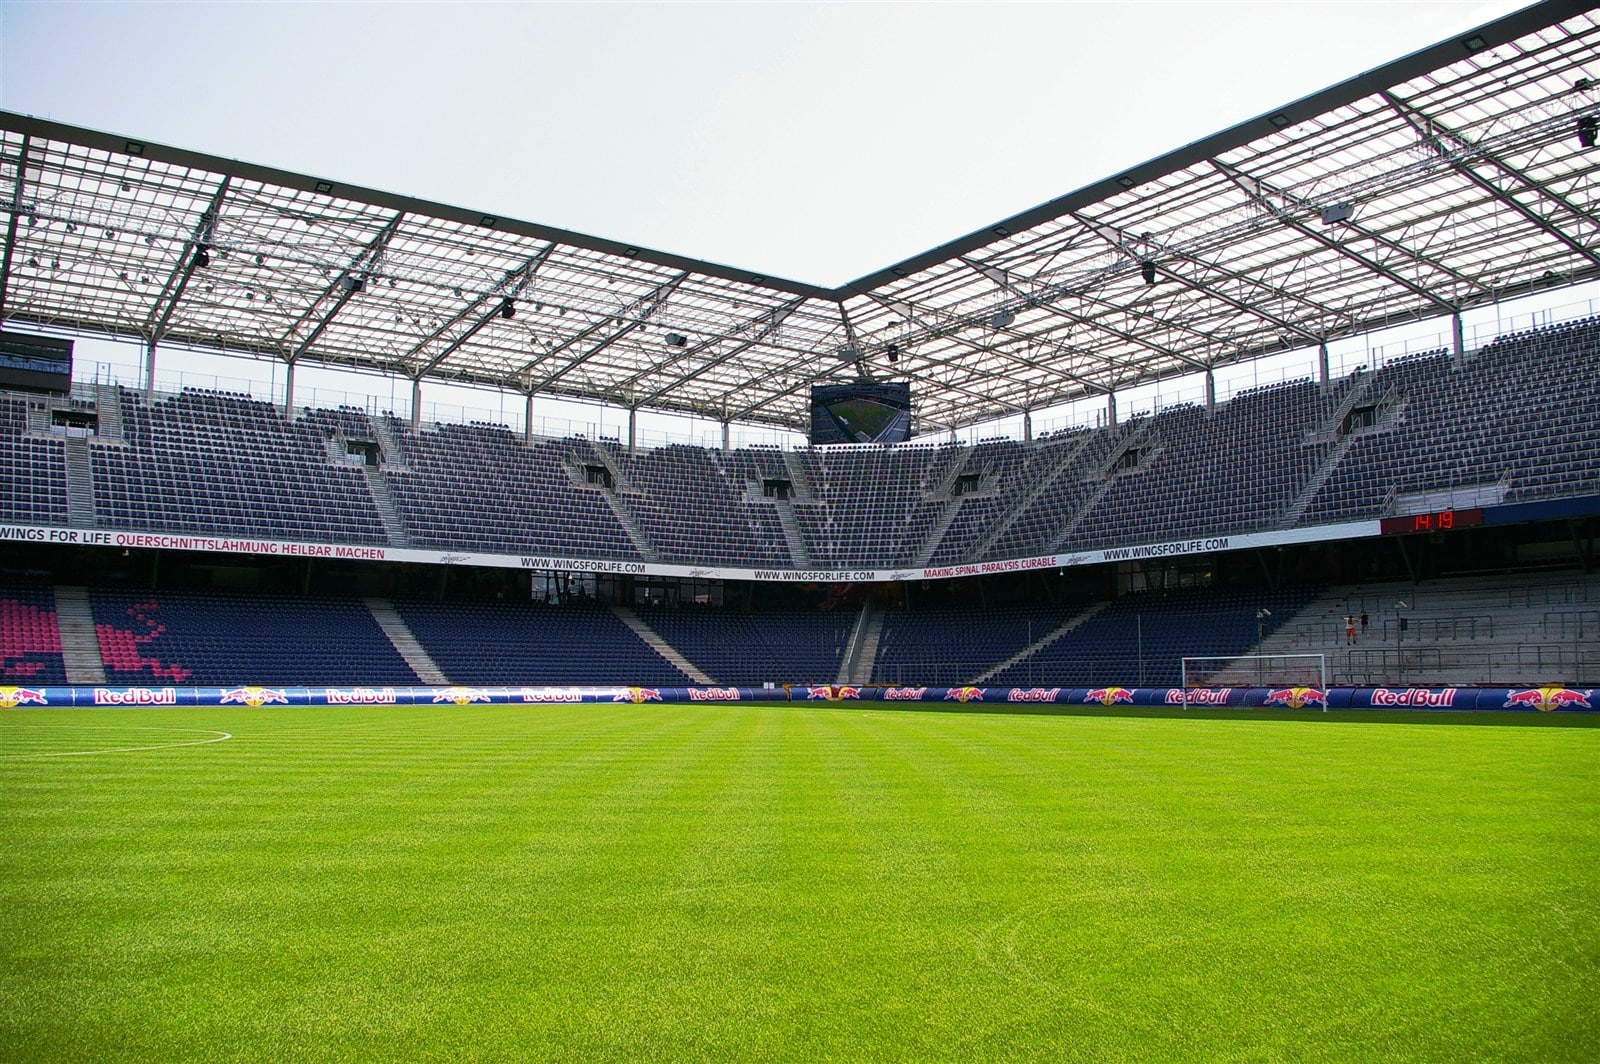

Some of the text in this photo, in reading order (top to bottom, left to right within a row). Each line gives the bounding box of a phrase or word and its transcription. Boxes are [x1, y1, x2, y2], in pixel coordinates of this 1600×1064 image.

[0, 527, 385, 560] WINGS FOR LIFE QUERSCHNITTSLÄHMUNG HEILBAR MACHEN
[1103, 538, 1229, 561] WWW.WINGSFORLIFE.COM
[520, 557, 646, 574] WWW.WINGSFORLIFE.COM
[754, 570, 875, 581] WWW.WINGSFORLIFE.COM
[923, 567, 954, 578] MAKING
[955, 564, 981, 576] SPINAL
[981, 560, 1019, 573] PARALYSIS
[1021, 556, 1057, 569] CURABLE
